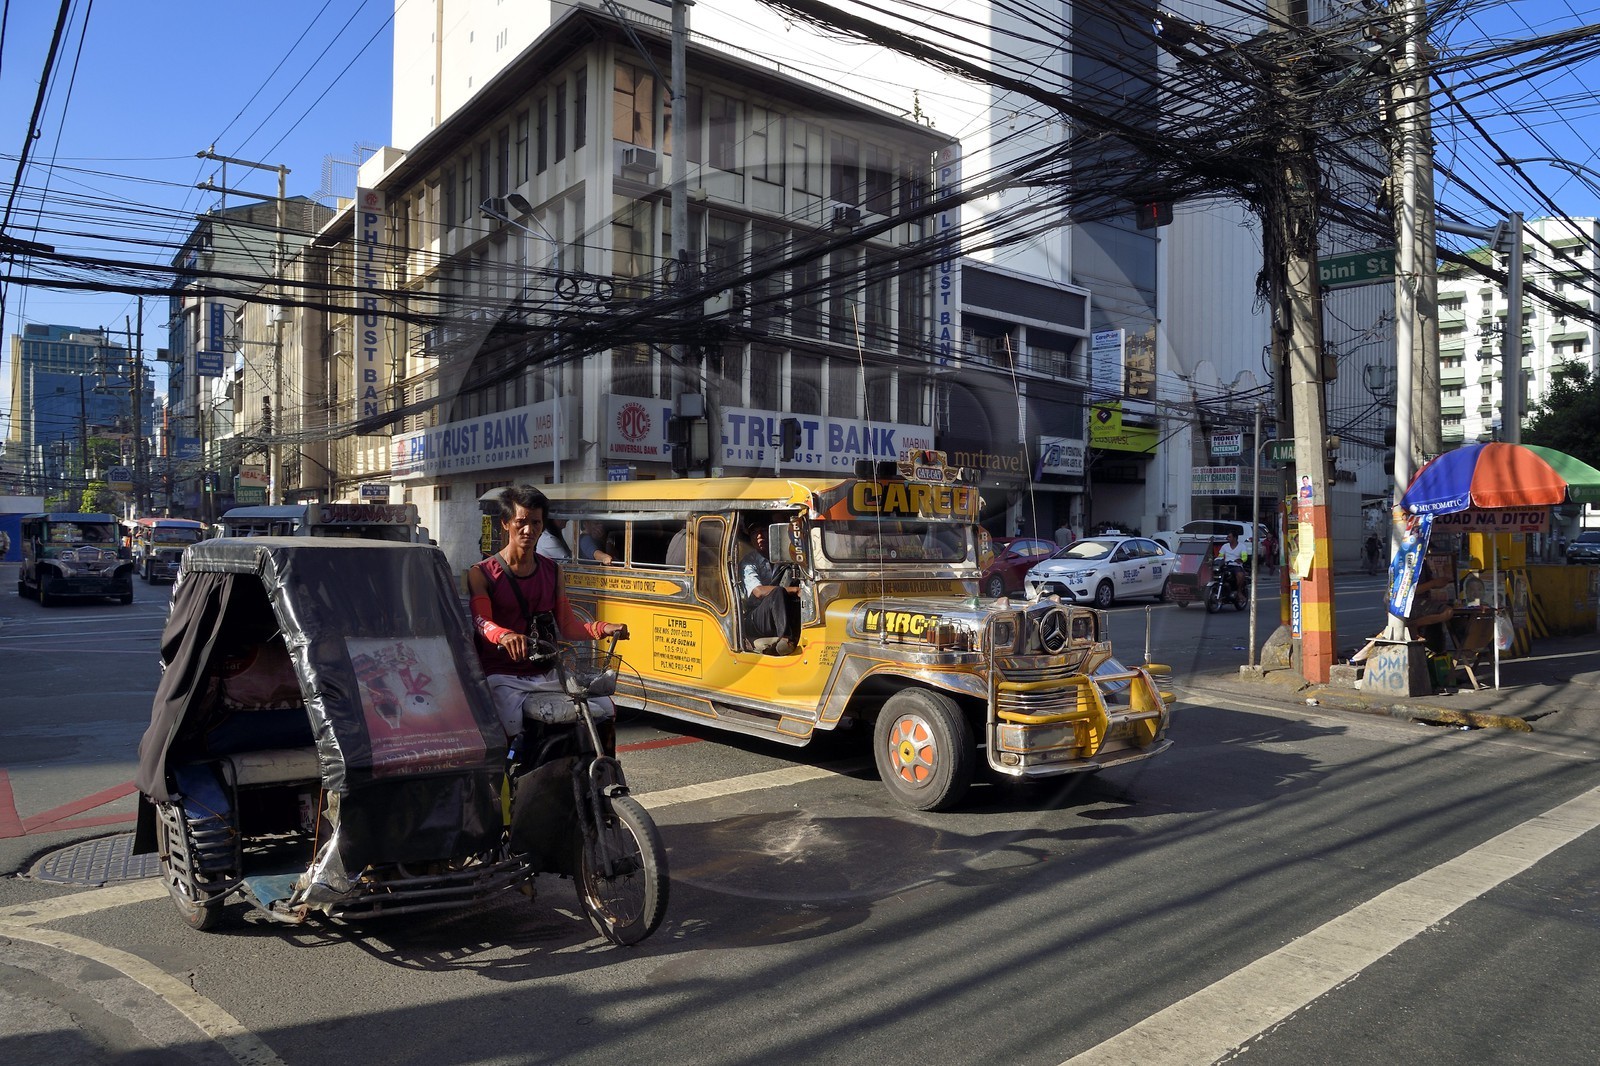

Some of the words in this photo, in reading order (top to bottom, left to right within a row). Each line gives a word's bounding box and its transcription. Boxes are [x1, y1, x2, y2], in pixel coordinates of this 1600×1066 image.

[1366, 258, 1388, 274] St
[364, 369, 378, 430] BAN
[536, 414, 562, 432] MABII
[410, 424, 479, 462] PHILTRUST
[484, 413, 530, 450] BANK
[534, 433, 564, 450] BRANH
[828, 424, 896, 457] BANK
[902, 437, 930, 449] MABINI
[456, 455, 480, 467] TRUST
[486, 448, 530, 463] COMPANY
[615, 444, 642, 454] UNIVERSAL
[644, 446, 658, 455] BANK
[1273, 446, 1280, 460] A.
[954, 450, 1024, 472] mrtravel
[1419, 499, 1462, 512] MICROMATIC
[1476, 513, 1496, 524] NA
[1502, 512, 1546, 524] DITO!
[668, 619, 687, 628] LTFRB
